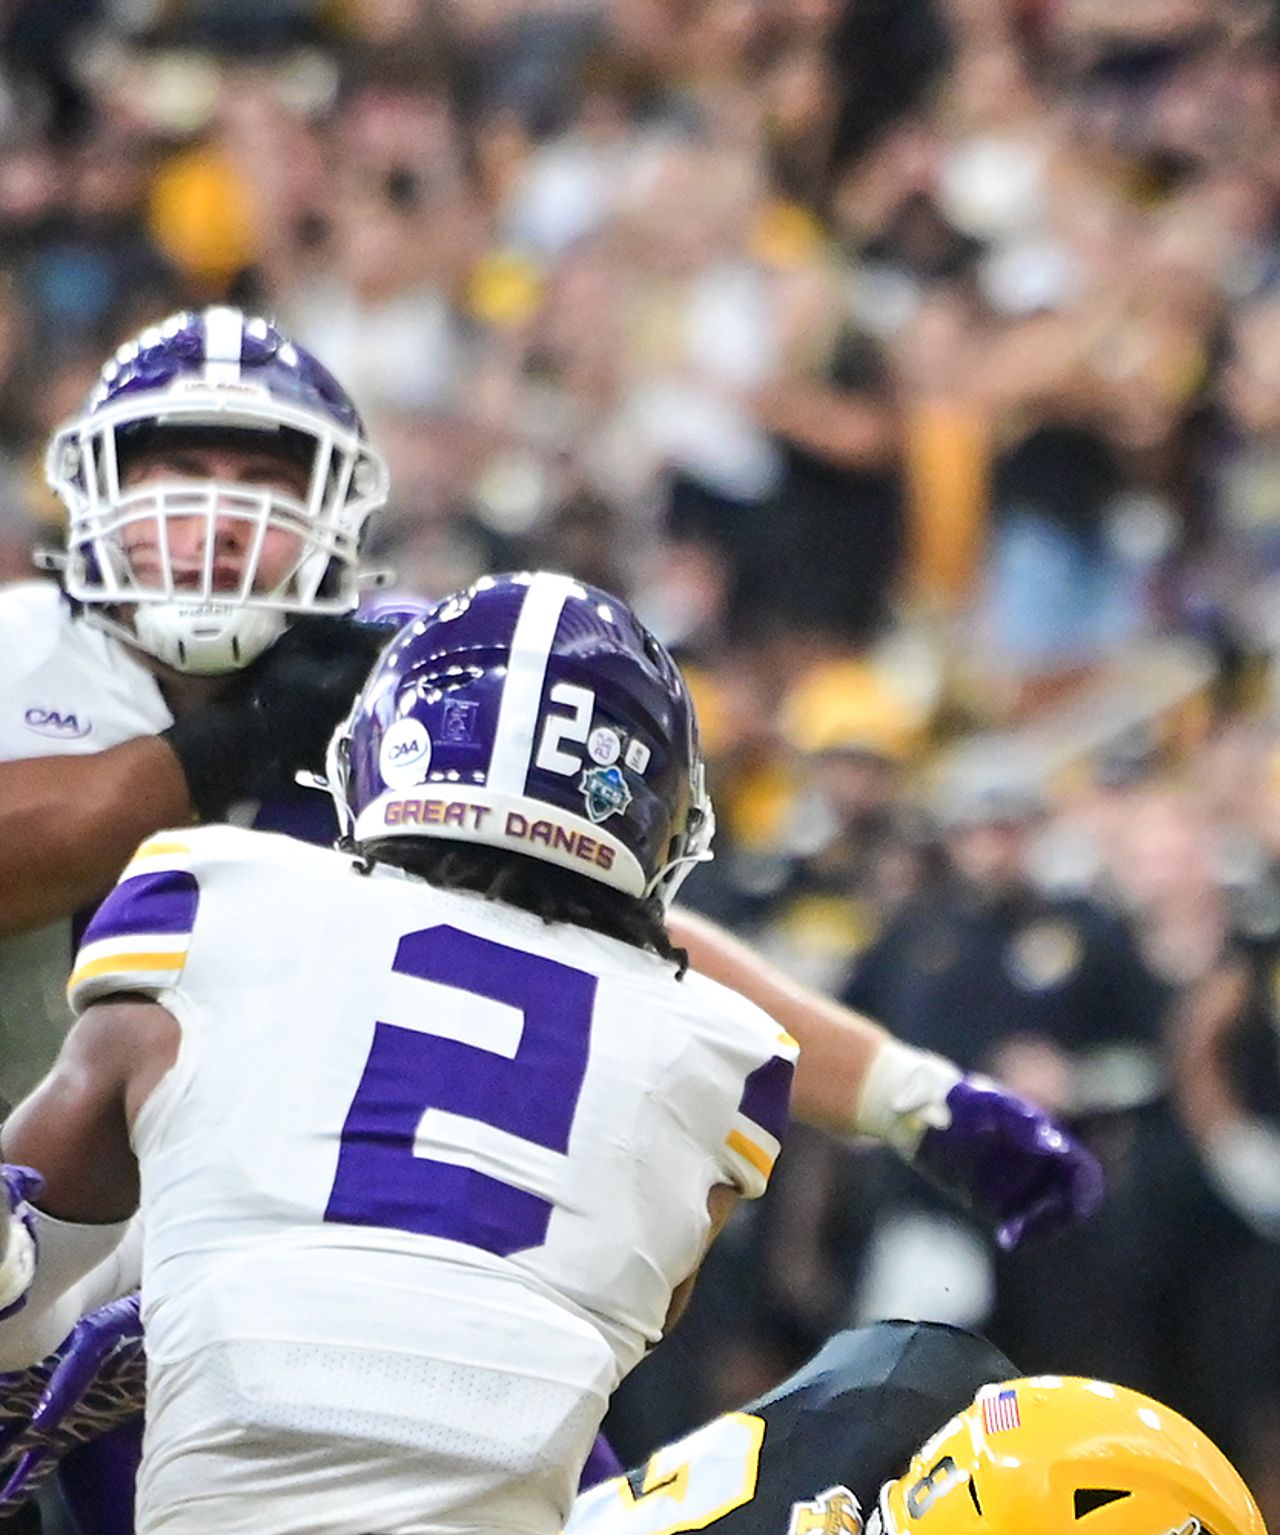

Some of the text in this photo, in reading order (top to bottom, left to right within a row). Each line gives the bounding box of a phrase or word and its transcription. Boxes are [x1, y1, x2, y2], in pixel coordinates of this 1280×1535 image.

[23, 707, 81, 734] CAA
[389, 738, 420, 761] CAA
[535, 682, 596, 777] 2
[383, 798, 618, 872] GREAT DANES
[322, 923, 600, 1258] 2
